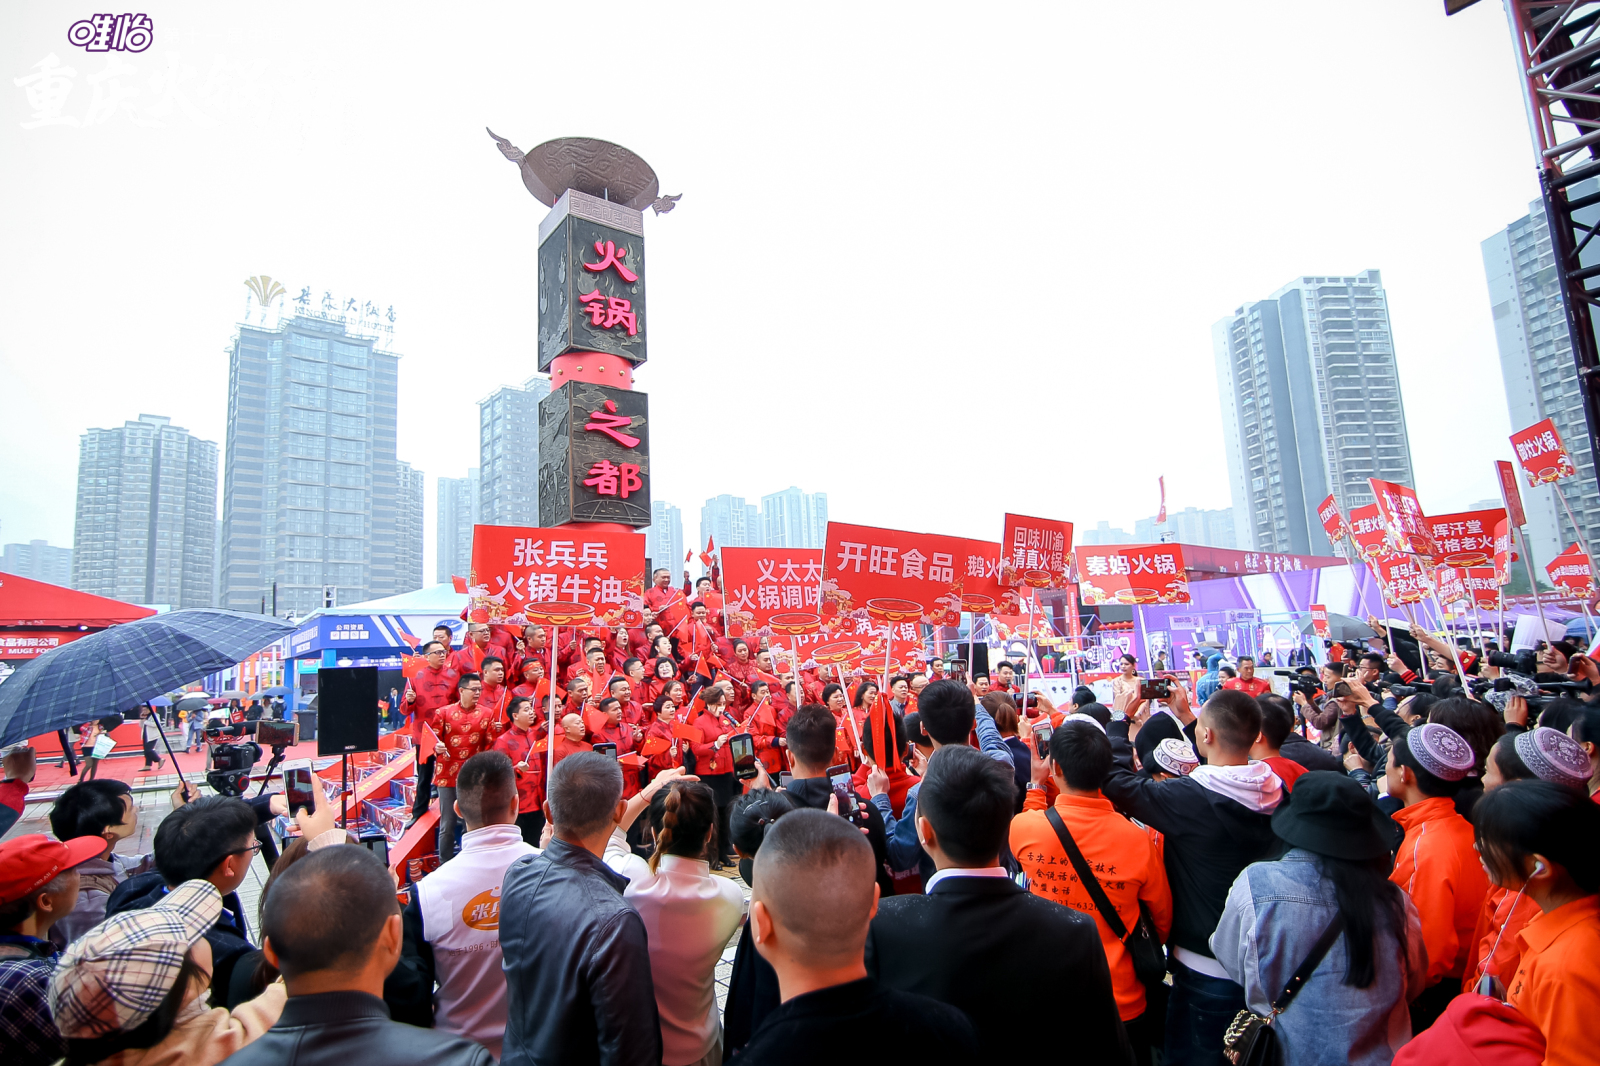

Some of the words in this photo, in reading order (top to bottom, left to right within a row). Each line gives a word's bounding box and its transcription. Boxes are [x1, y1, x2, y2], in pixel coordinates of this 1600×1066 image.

[1013, 526, 1065, 551] 回味川渝
[1432, 519, 1483, 538] 挥汗堂
[513, 538, 608, 570] 张兵兵
[837, 541, 954, 583] 开旺食品
[1012, 548, 1064, 571] 清真火锅
[1086, 554, 1176, 576] 秦妈火锅
[757, 558, 822, 583] 义太太
[495, 572, 622, 604] 火锅牛油
